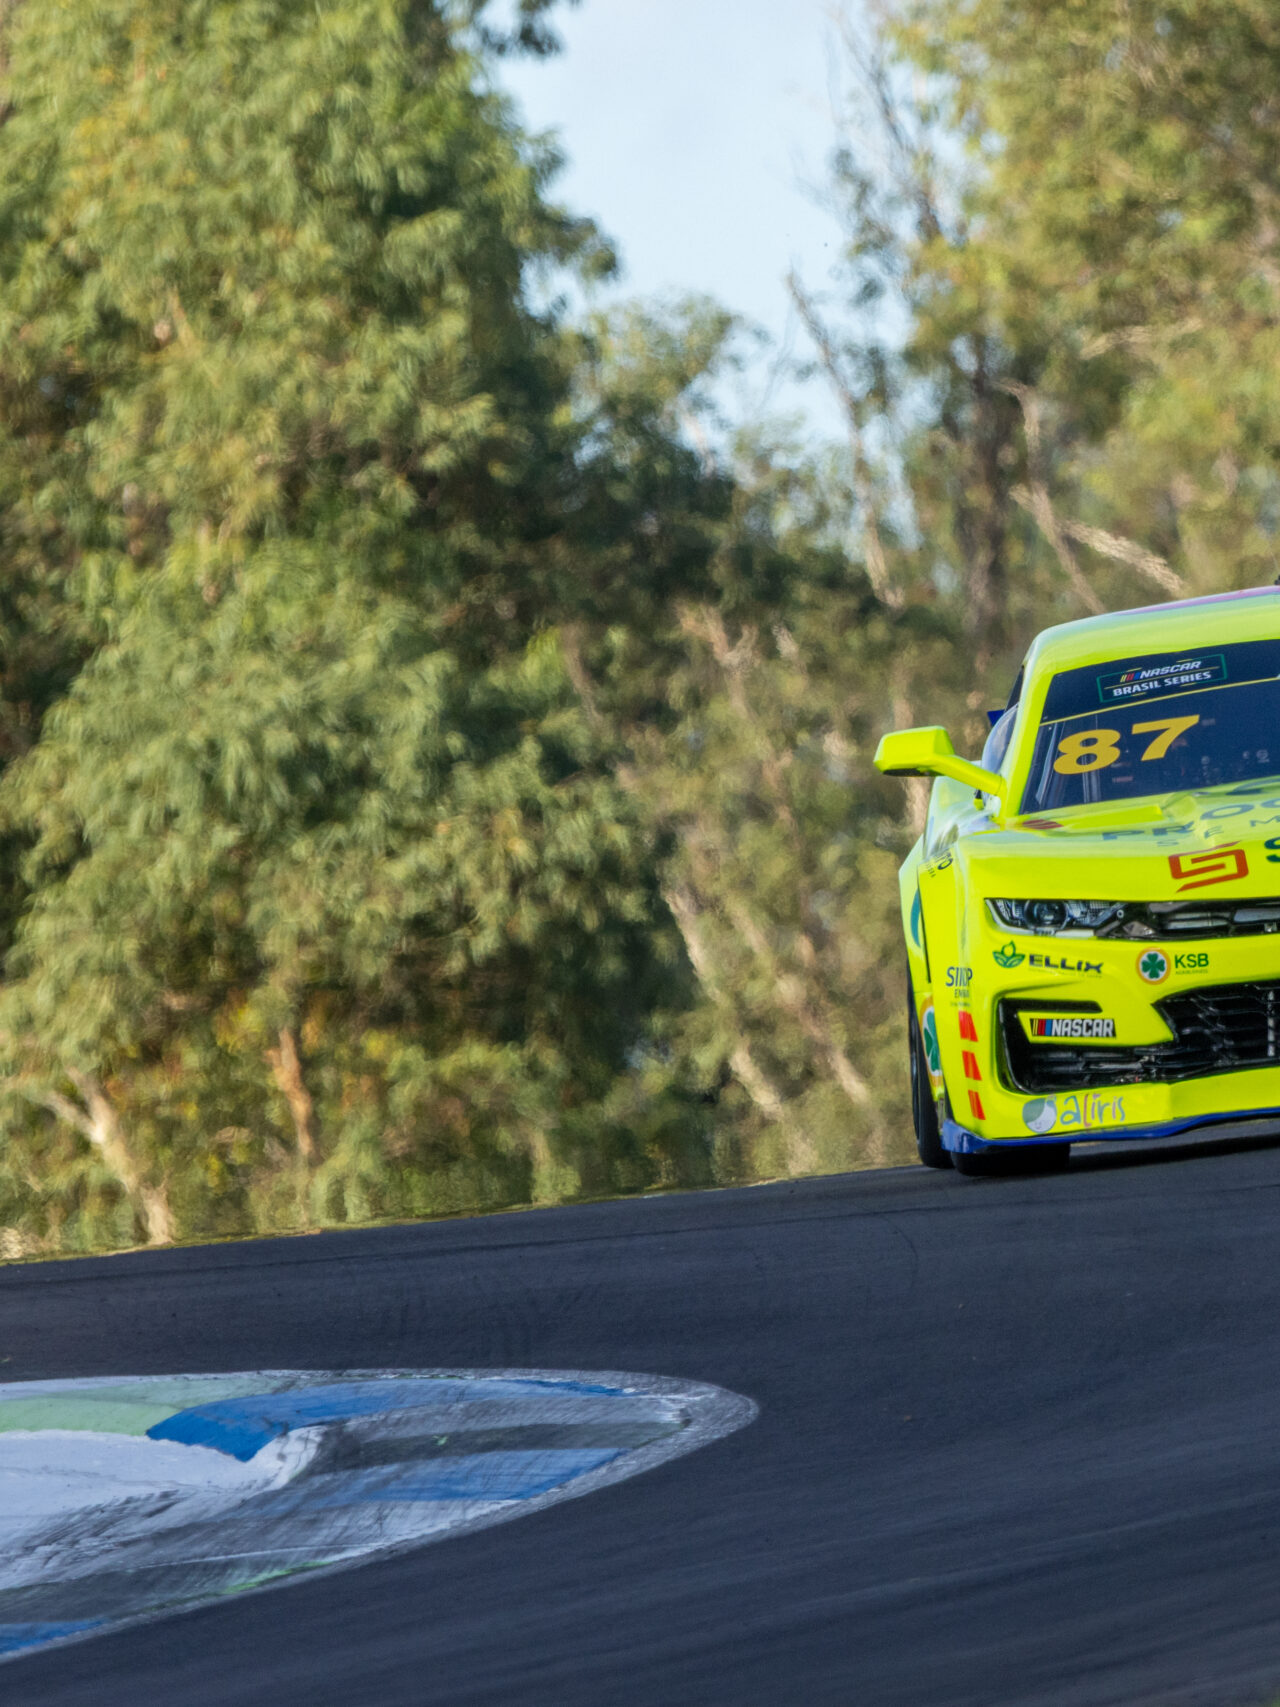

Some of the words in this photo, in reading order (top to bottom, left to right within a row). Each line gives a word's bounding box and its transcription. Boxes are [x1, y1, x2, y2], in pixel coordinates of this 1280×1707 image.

[1139, 660, 1202, 680] NASCAR
[1112, 681, 1162, 697] BRASIL
[1164, 671, 1212, 687] SERIES
[1053, 714, 1200, 775] 87
[1029, 953, 1104, 974] ELLIX
[1174, 953, 1209, 969] KSB
[1051, 1018, 1114, 1038] NASCAR
